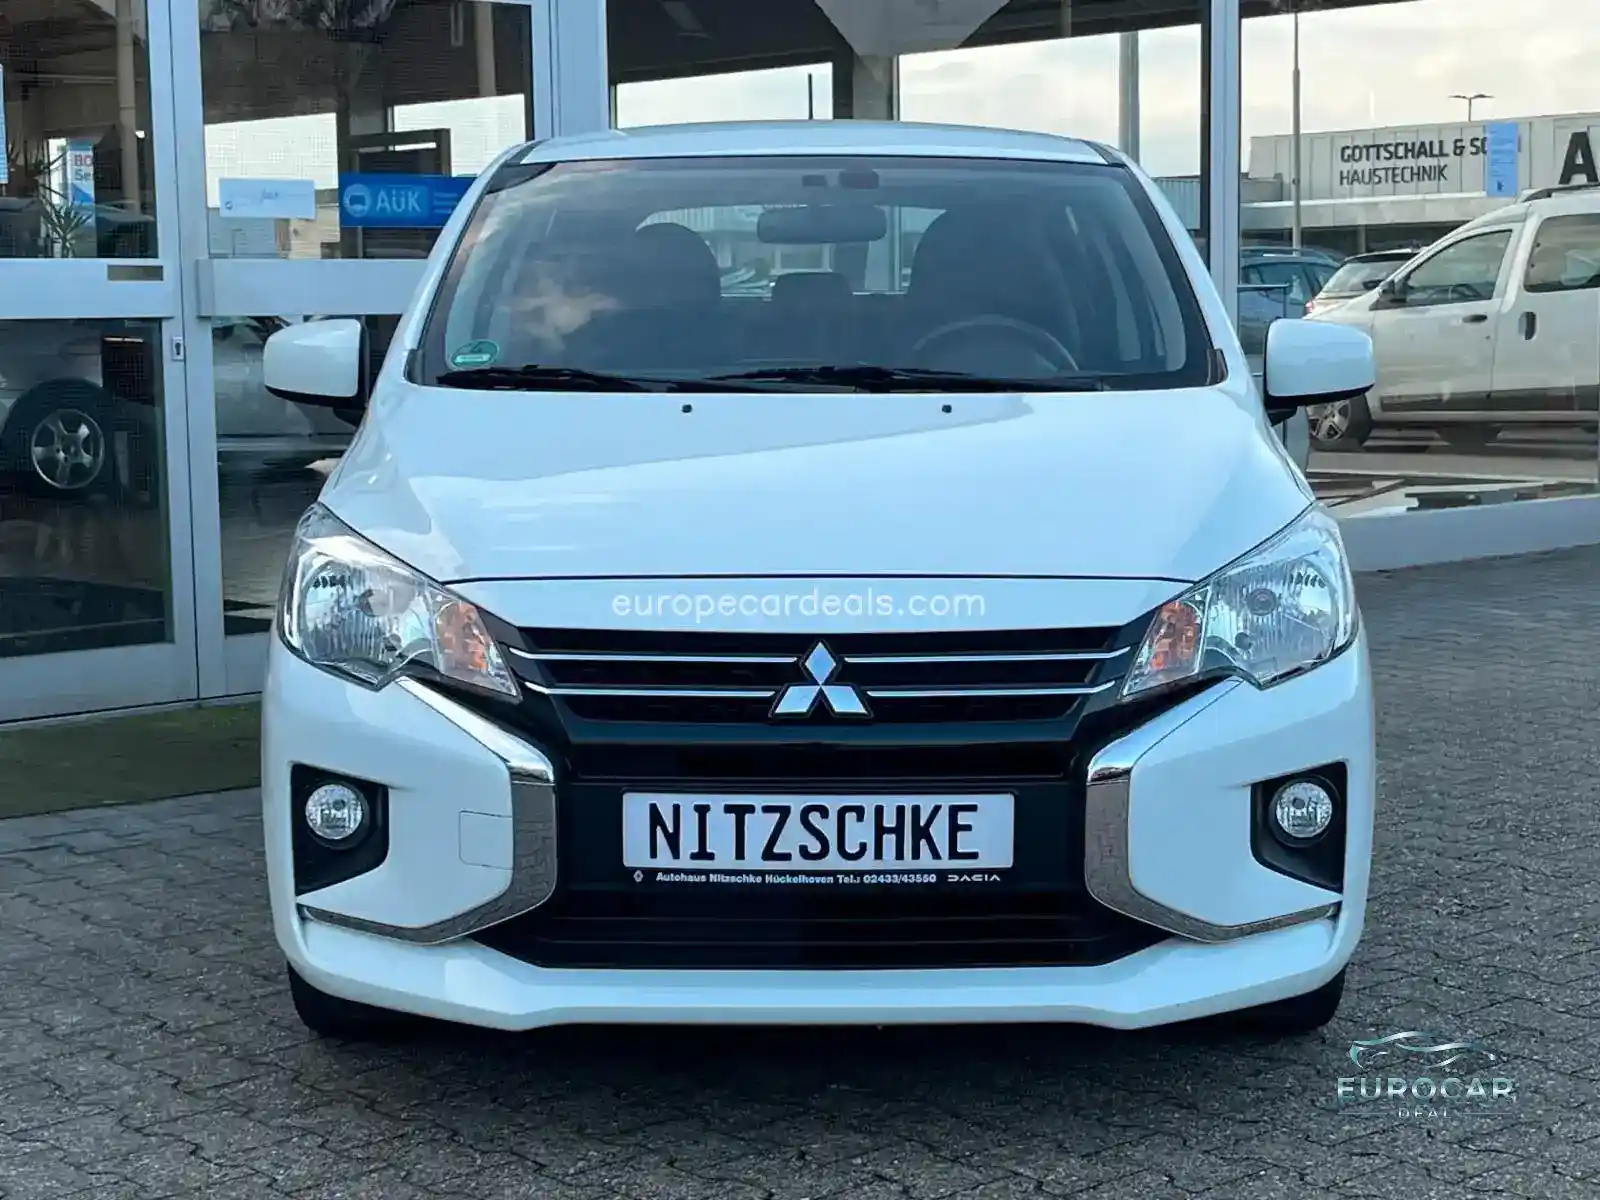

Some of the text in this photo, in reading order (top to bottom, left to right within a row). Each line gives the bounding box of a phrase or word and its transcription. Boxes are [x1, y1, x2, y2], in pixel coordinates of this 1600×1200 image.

[1340, 139, 1449, 163] GOTTSCHALL
[1452, 138, 1466, 157] &
[1339, 164, 1448, 186] HAUSTECHNIK
[648, 802, 980, 862] NITZSCHKE
[655, 872, 707, 883] Autohaus
[709, 873, 762, 884] Nitzschke
[765, 873, 834, 885] Hückelhoven
[947, 874, 1001, 882] DACIA
